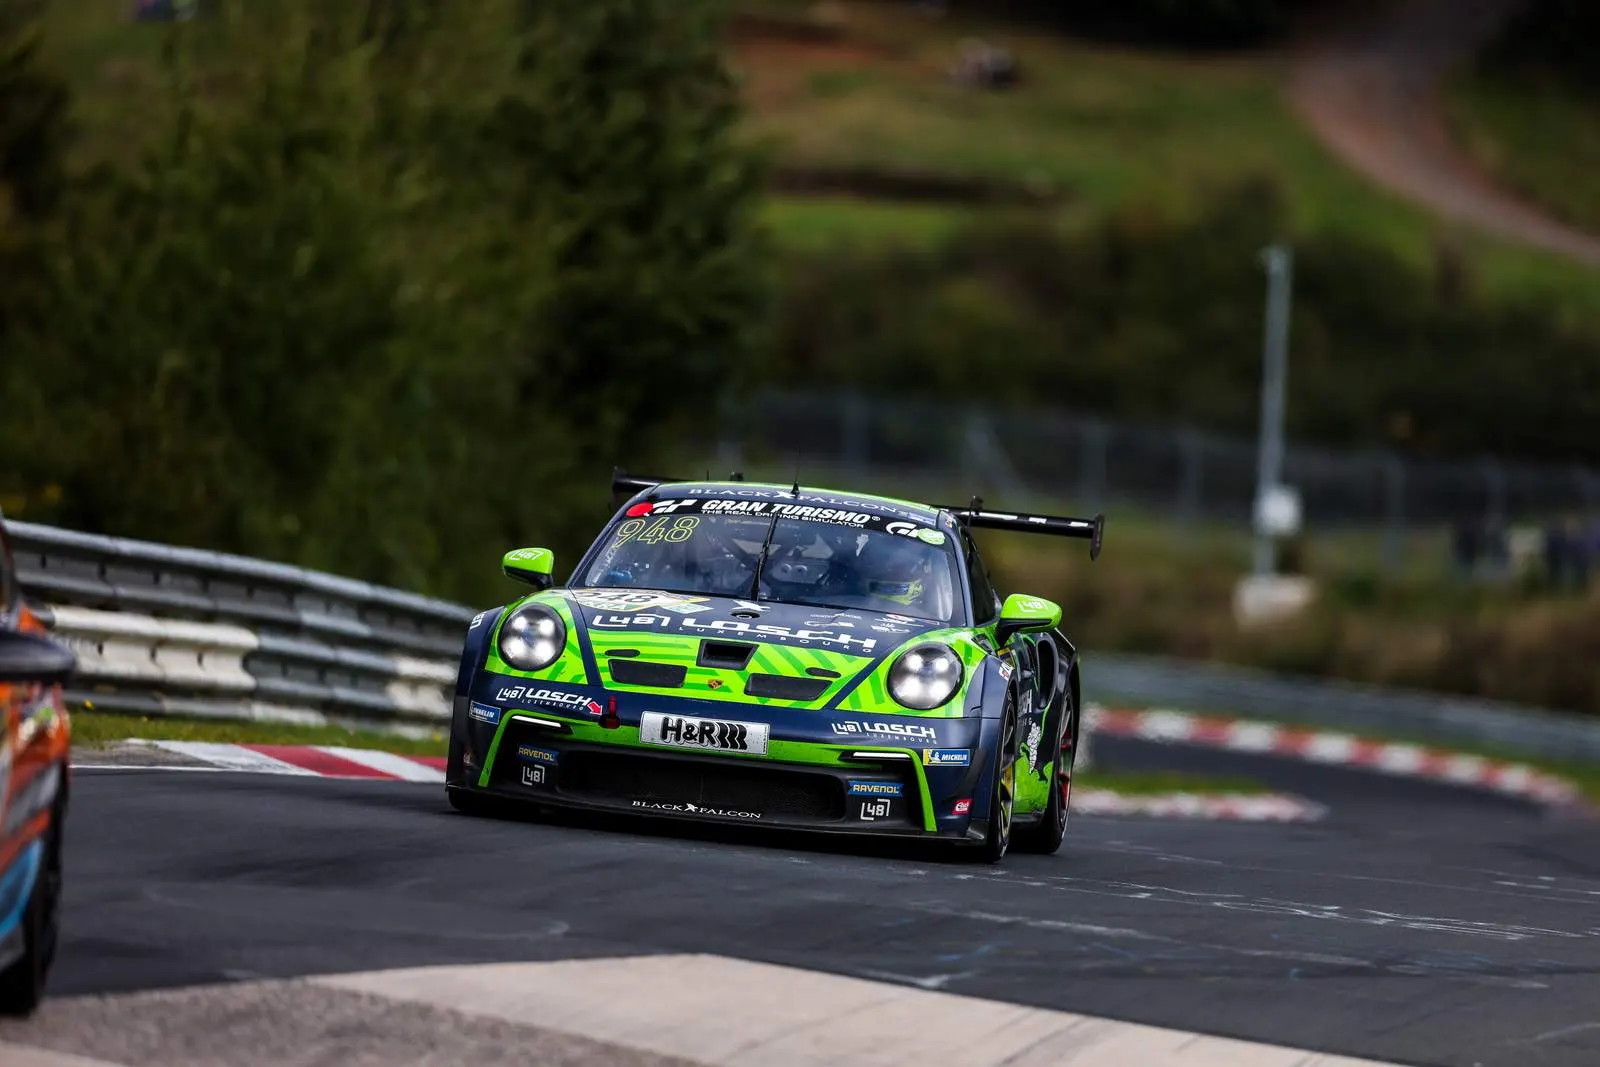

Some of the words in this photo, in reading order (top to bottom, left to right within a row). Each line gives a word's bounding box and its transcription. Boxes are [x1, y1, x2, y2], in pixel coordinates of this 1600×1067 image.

[687, 488, 772, 498] BLACK
[797, 494, 898, 513] FALCON
[701, 499, 768, 513] GRAN
[723, 510, 755, 518] REAL
[756, 512, 800, 520] DRIING
[801, 516, 865, 529] SIMULATOR
[614, 516, 701, 547] 948
[682, 618, 877, 649] LOSCH
[525, 687, 593, 706] LOSCH
[660, 716, 720, 746] H&R
[862, 721, 937, 739] LOSCH
[518, 747, 556, 762] RAVENOL
[852, 783, 900, 794] RAVENOL
[631, 800, 683, 812] BLACK
[699, 807, 762, 820] FALCON
